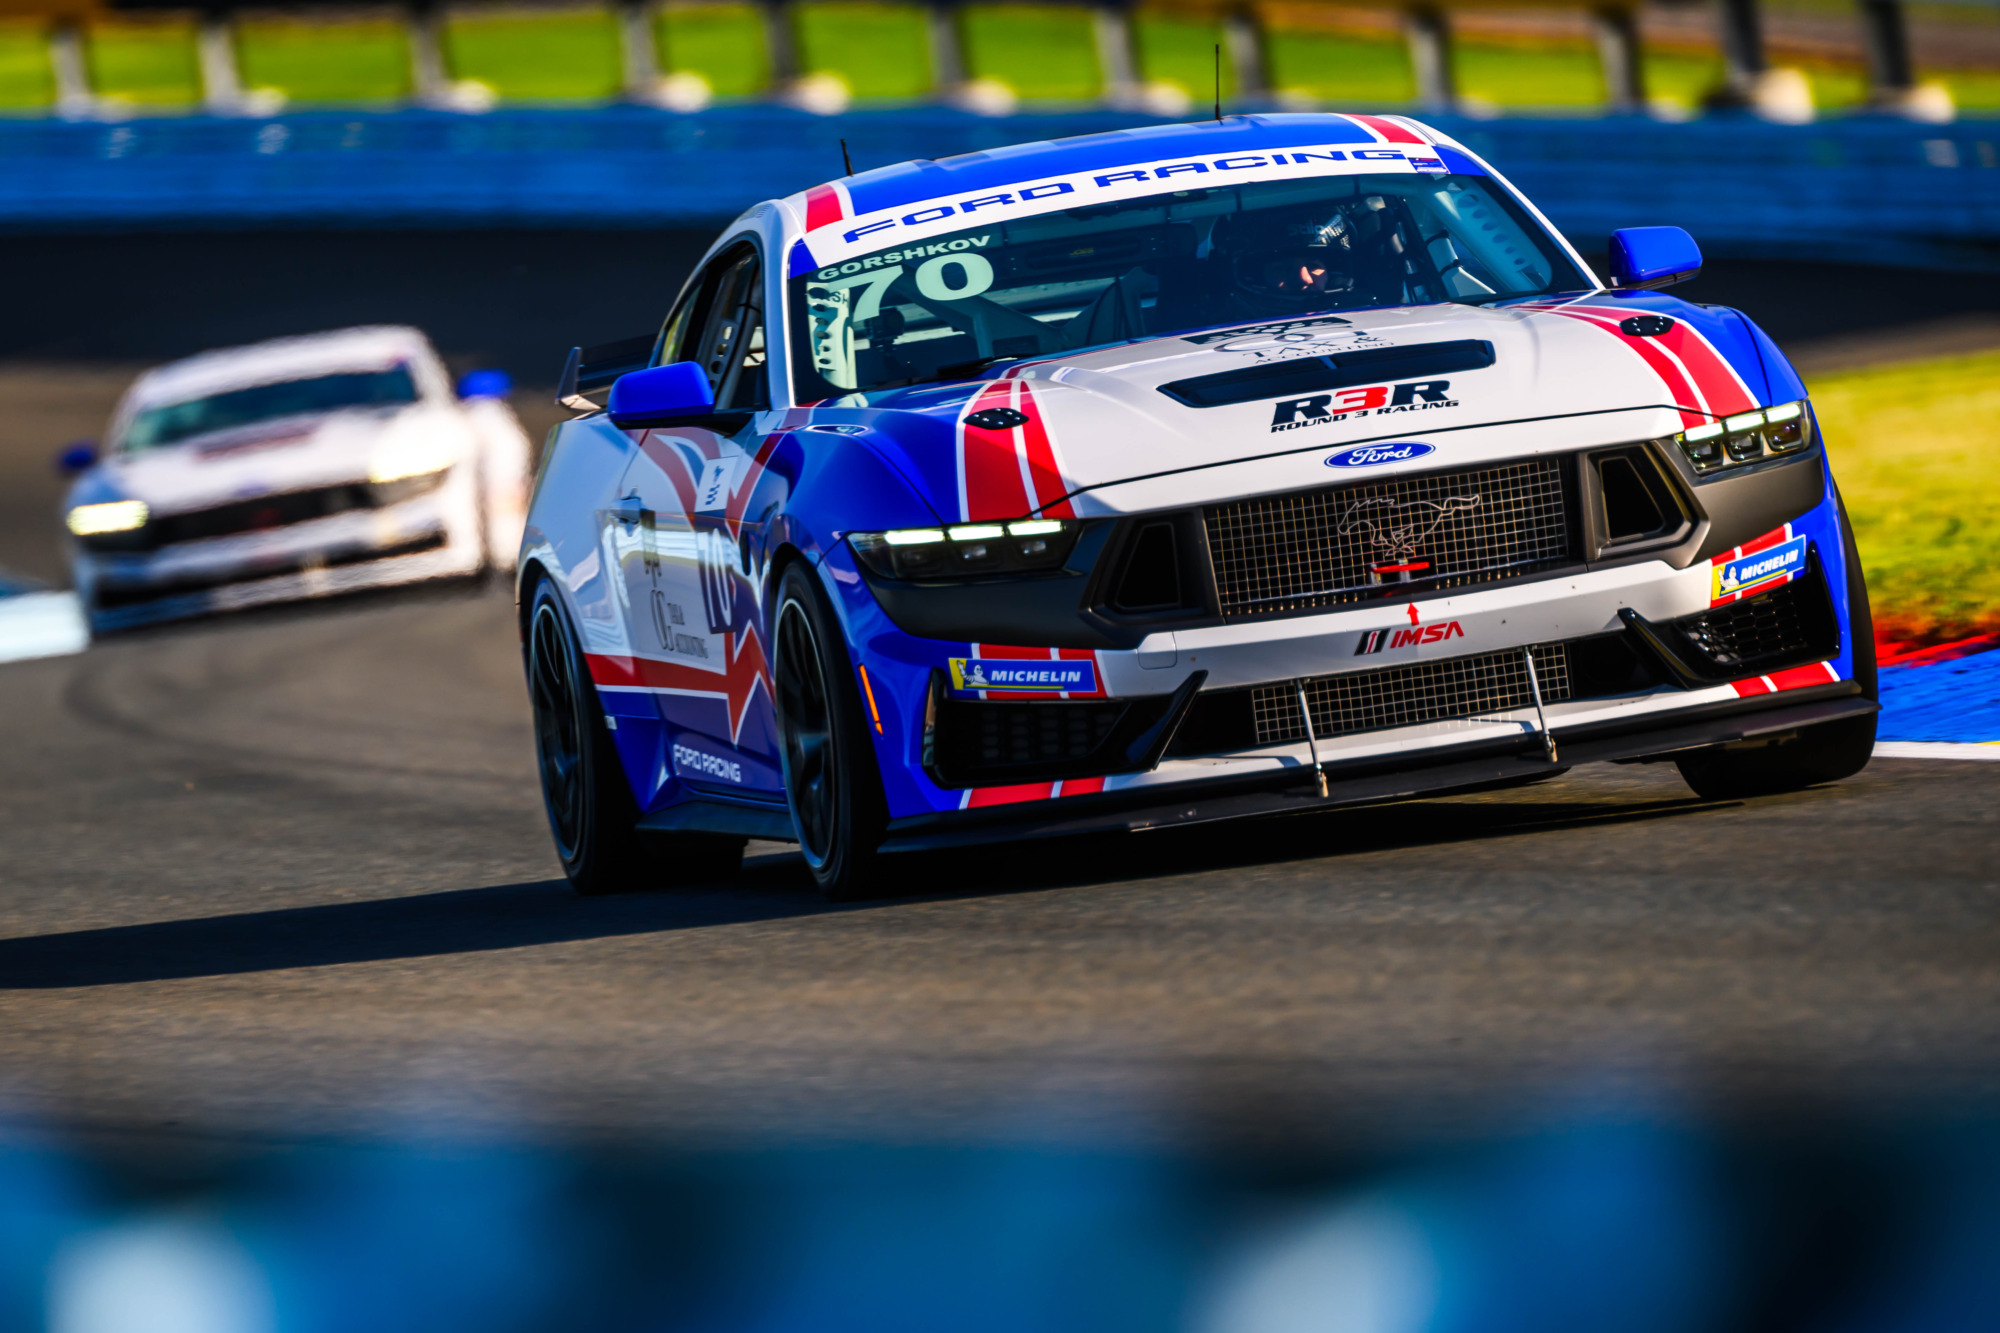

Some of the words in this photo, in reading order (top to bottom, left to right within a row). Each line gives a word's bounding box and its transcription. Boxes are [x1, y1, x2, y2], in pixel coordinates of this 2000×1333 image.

[843, 182, 1075, 243] FORD
[1093, 149, 1407, 188] RACING
[817, 235, 991, 280] GORSHKOV
[827, 252, 994, 323] 70
[1242, 340, 1337, 358] TAX
[1352, 336, 1388, 345] &
[1255, 341, 1395, 364] ACCOUNTING
[1270, 413, 1347, 433] ROUND
[1354, 410, 1369, 418] 3
[1376, 400, 1460, 415] RACING
[1271, 380, 1451, 427] R3R
[1348, 444, 1414, 465] Ford
[1740, 548, 1799, 581] MICHELIN
[1390, 620, 1465, 649] IMSA
[990, 670, 1081, 683] MICHELIN
[673, 743, 701, 770] FORD
[702, 753, 742, 783] RACING
